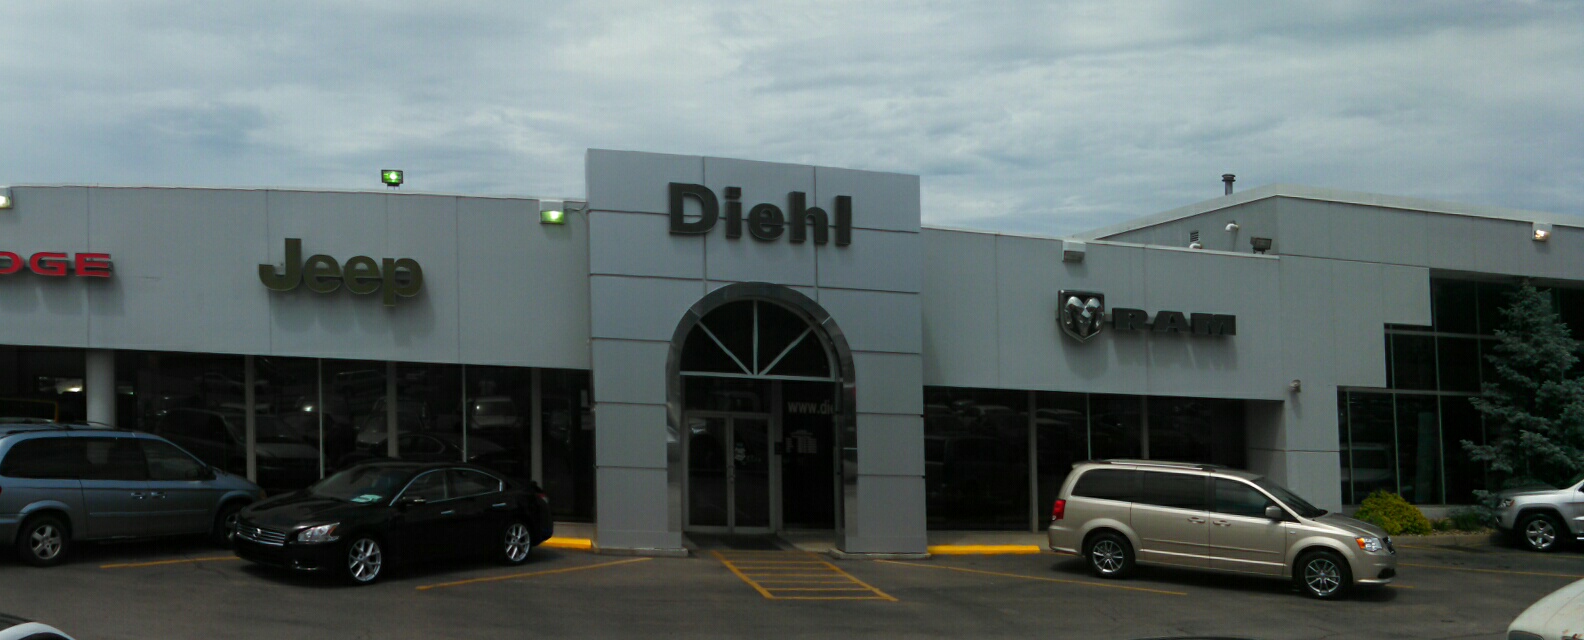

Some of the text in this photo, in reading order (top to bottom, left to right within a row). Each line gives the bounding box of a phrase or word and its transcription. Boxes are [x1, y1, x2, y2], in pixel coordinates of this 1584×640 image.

[669, 182, 852, 246] Diehl
[258, 237, 423, 307] Jeep
[1112, 308, 1236, 336] RAM
